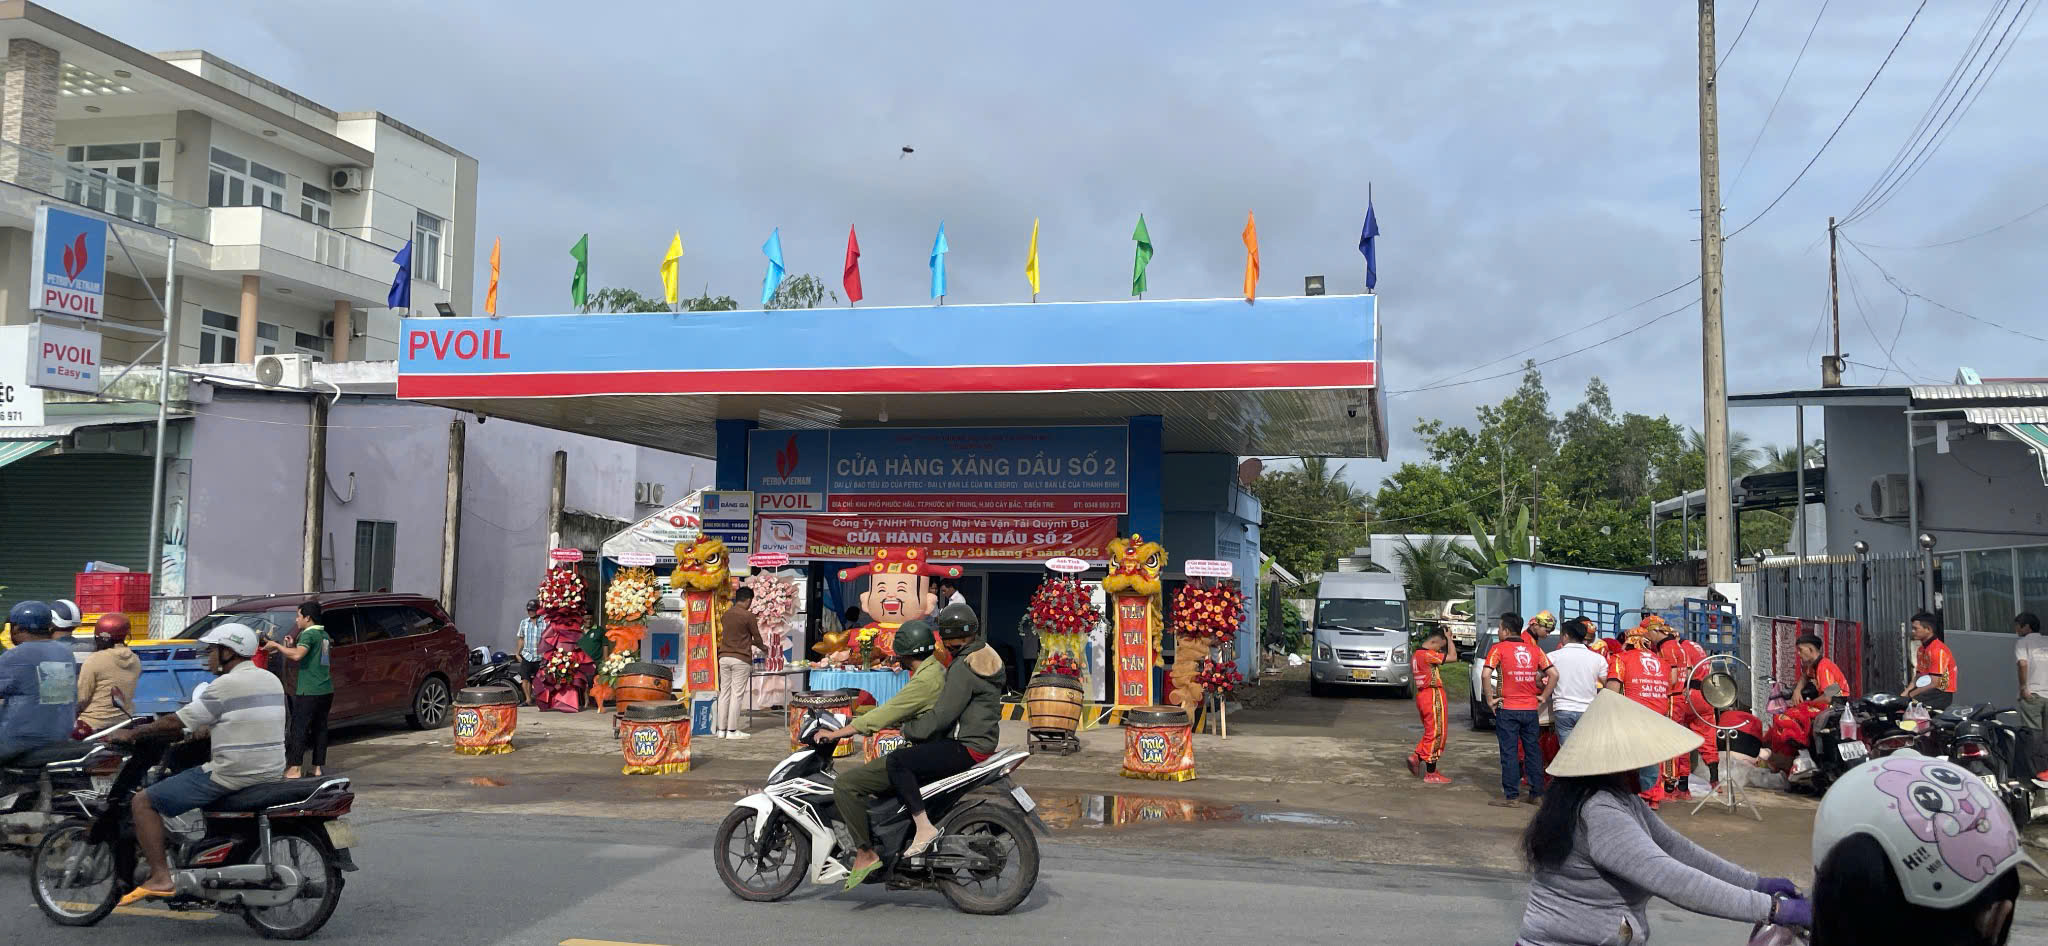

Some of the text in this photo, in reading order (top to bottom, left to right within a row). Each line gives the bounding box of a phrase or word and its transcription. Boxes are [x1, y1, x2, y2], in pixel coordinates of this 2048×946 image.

[46, 289, 98, 315] PVOIL
[409, 329, 511, 361] PVOIL
[43, 342, 96, 366] PVOIL
[57, 366, 80, 379] Easy
[836, 449, 1116, 476] CỬA HÀNG XĂNG DẦU SỐ 2
[760, 494, 812, 509] PVOIL
[832, 518, 859, 529] Công
[864, 519, 875, 530] Ty
[878, 519, 907, 528] TNHH
[910, 519, 948, 529] Thương
[952, 519, 970, 530] Mại
[974, 519, 987, 528] Và
[990, 519, 1010, 530] Vận
[1013, 518, 1029, 528] Tải
[1071, 519, 1089, 530] Đạt
[846, 529, 1073, 544] CỬA HÀNG XĂNG DẦU SỐ 2
[933, 548, 963, 558] ngày
[967, 547, 983, 556] 30
[985, 547, 1022, 558] tháng
[1025, 547, 1033, 556] 5
[1036, 548, 1066, 557] năm
[1071, 547, 1099, 557] 2025
[458, 711, 478, 725] TRÚC
[457, 723, 474, 737] LÂM
[634, 729, 658, 742] TRÚC
[637, 742, 655, 756] LÂM
[1141, 736, 1165, 749] TRÚC
[1142, 750, 1163, 763] LÂM
